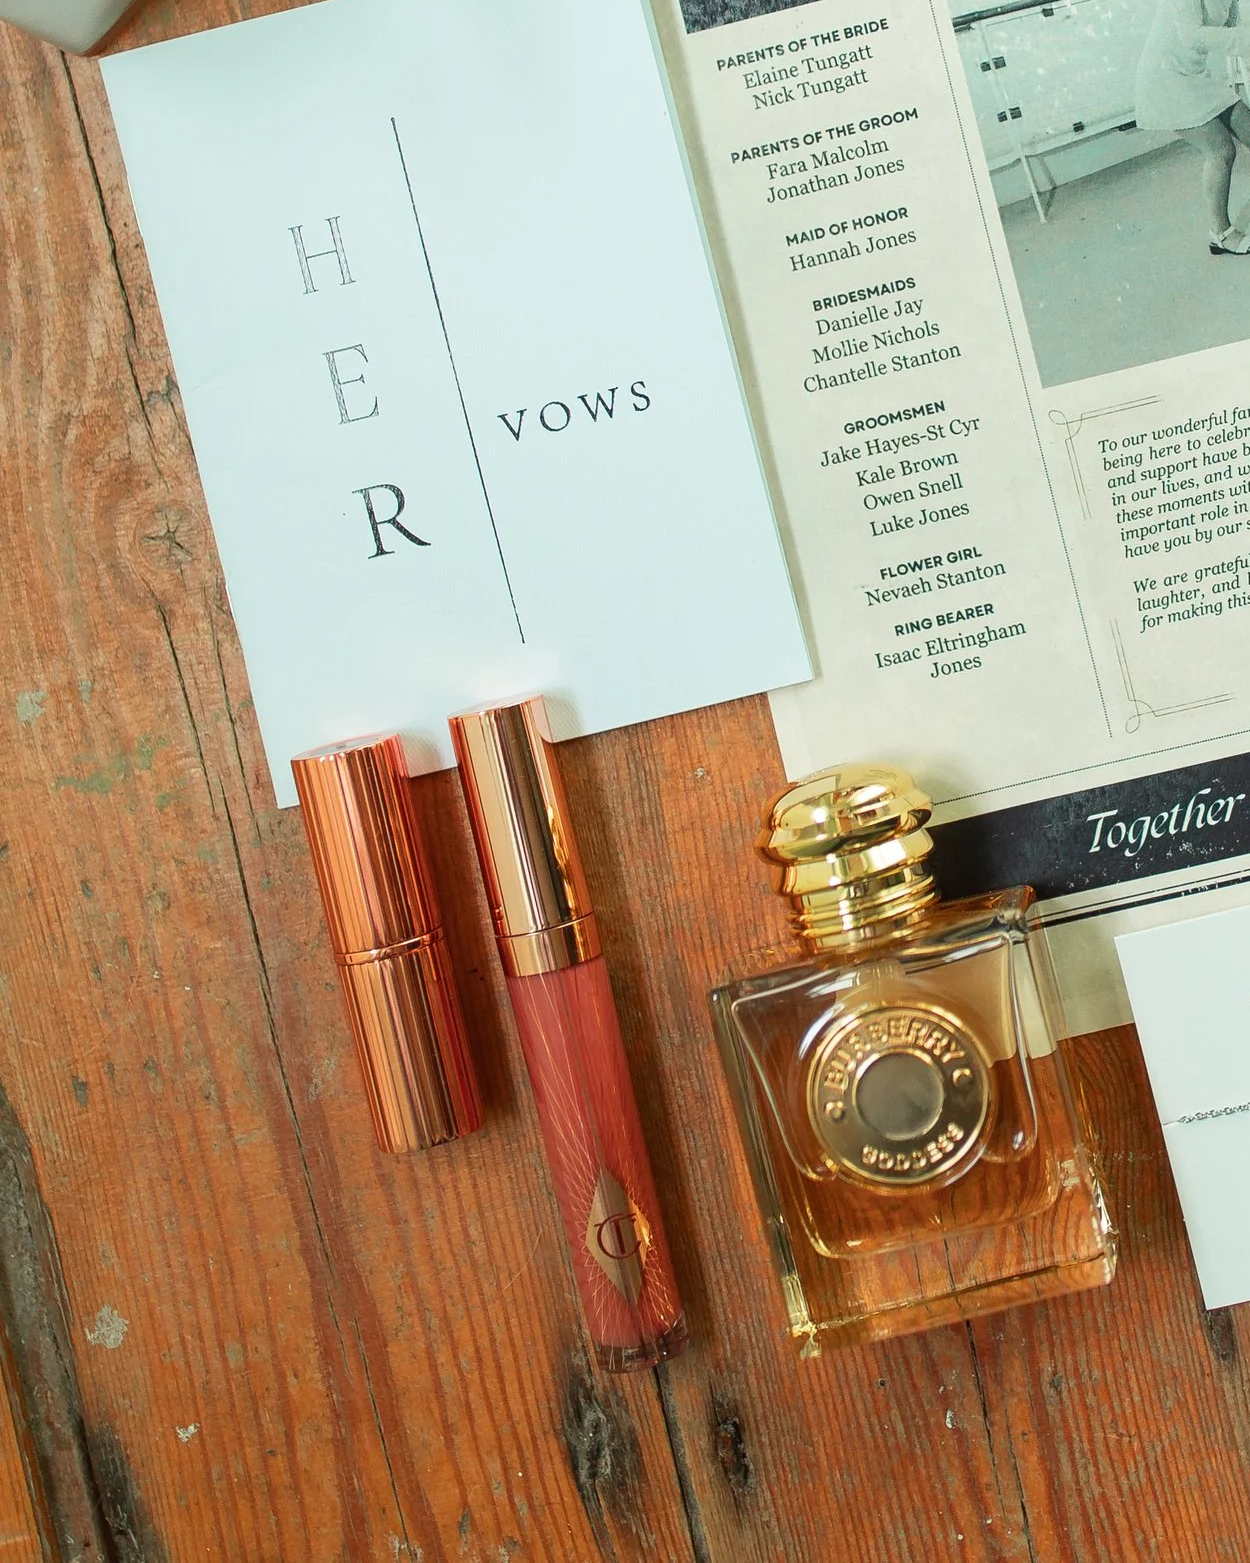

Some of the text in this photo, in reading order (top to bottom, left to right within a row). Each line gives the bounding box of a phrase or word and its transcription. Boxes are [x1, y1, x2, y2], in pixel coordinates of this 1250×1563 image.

[716, 18, 889, 71] PARENTS OF THE BRIDE
[742, 44, 874, 89] Elaine Tungatt
[752, 68, 869, 110] Nick Tungatt
[730, 107, 919, 164] PARENTS OF THE GROOM
[766, 139, 890, 180] Fara Malcolm
[766, 159, 905, 204] Jonathan Jones
[785, 206, 909, 247] MAID OF HONOR
[789, 230, 917, 272] Hannah Jones
[812, 277, 916, 312] BRIDESMAIDS
[815, 299, 923, 336] Danielle Jay
[811, 320, 941, 364] Mollie Nichols
[803, 345, 962, 393] Chantelle Stanton
[496, 380, 651, 442] VOWS
[843, 400, 946, 435] GROOMSMEN
[1097, 438, 1118, 454] To
[1121, 433, 1148, 448] our
[1151, 409, 1229, 441] wonderful
[820, 418, 980, 468] Jake Hayes-St Cyr
[1102, 453, 1143, 472] being
[1148, 443, 1181, 461] here
[1186, 439, 1202, 452] to
[855, 452, 959, 487] Kale Brown
[1111, 492, 1127, 507] in
[1131, 486, 1157, 502] our
[1161, 478, 1200, 495] lives,
[1204, 464, 1233, 485] and
[863, 472, 964, 510] Owen Snell
[869, 503, 970, 537] Luke Jones
[1124, 541, 1160, 559] have
[1163, 534, 1192, 553] you
[1194, 528, 1213, 544] by
[1216, 522, 1243, 537] our
[879, 546, 983, 581] FLOWER GIRL
[1133, 577, 1157, 594] We
[1163, 572, 1188, 587] are
[864, 563, 1007, 607] Nevaeh Stanton
[1137, 588, 1205, 612] laughter,
[1211, 574, 1241, 594] and
[894, 603, 995, 637] RING BEARER
[1139, 614, 1164, 634] for
[1167, 601, 1223, 624] making
[874, 622, 1027, 669] Isaac Eltringham
[930, 656, 982, 679] Jones
[1083, 787, 1246, 858] Together
